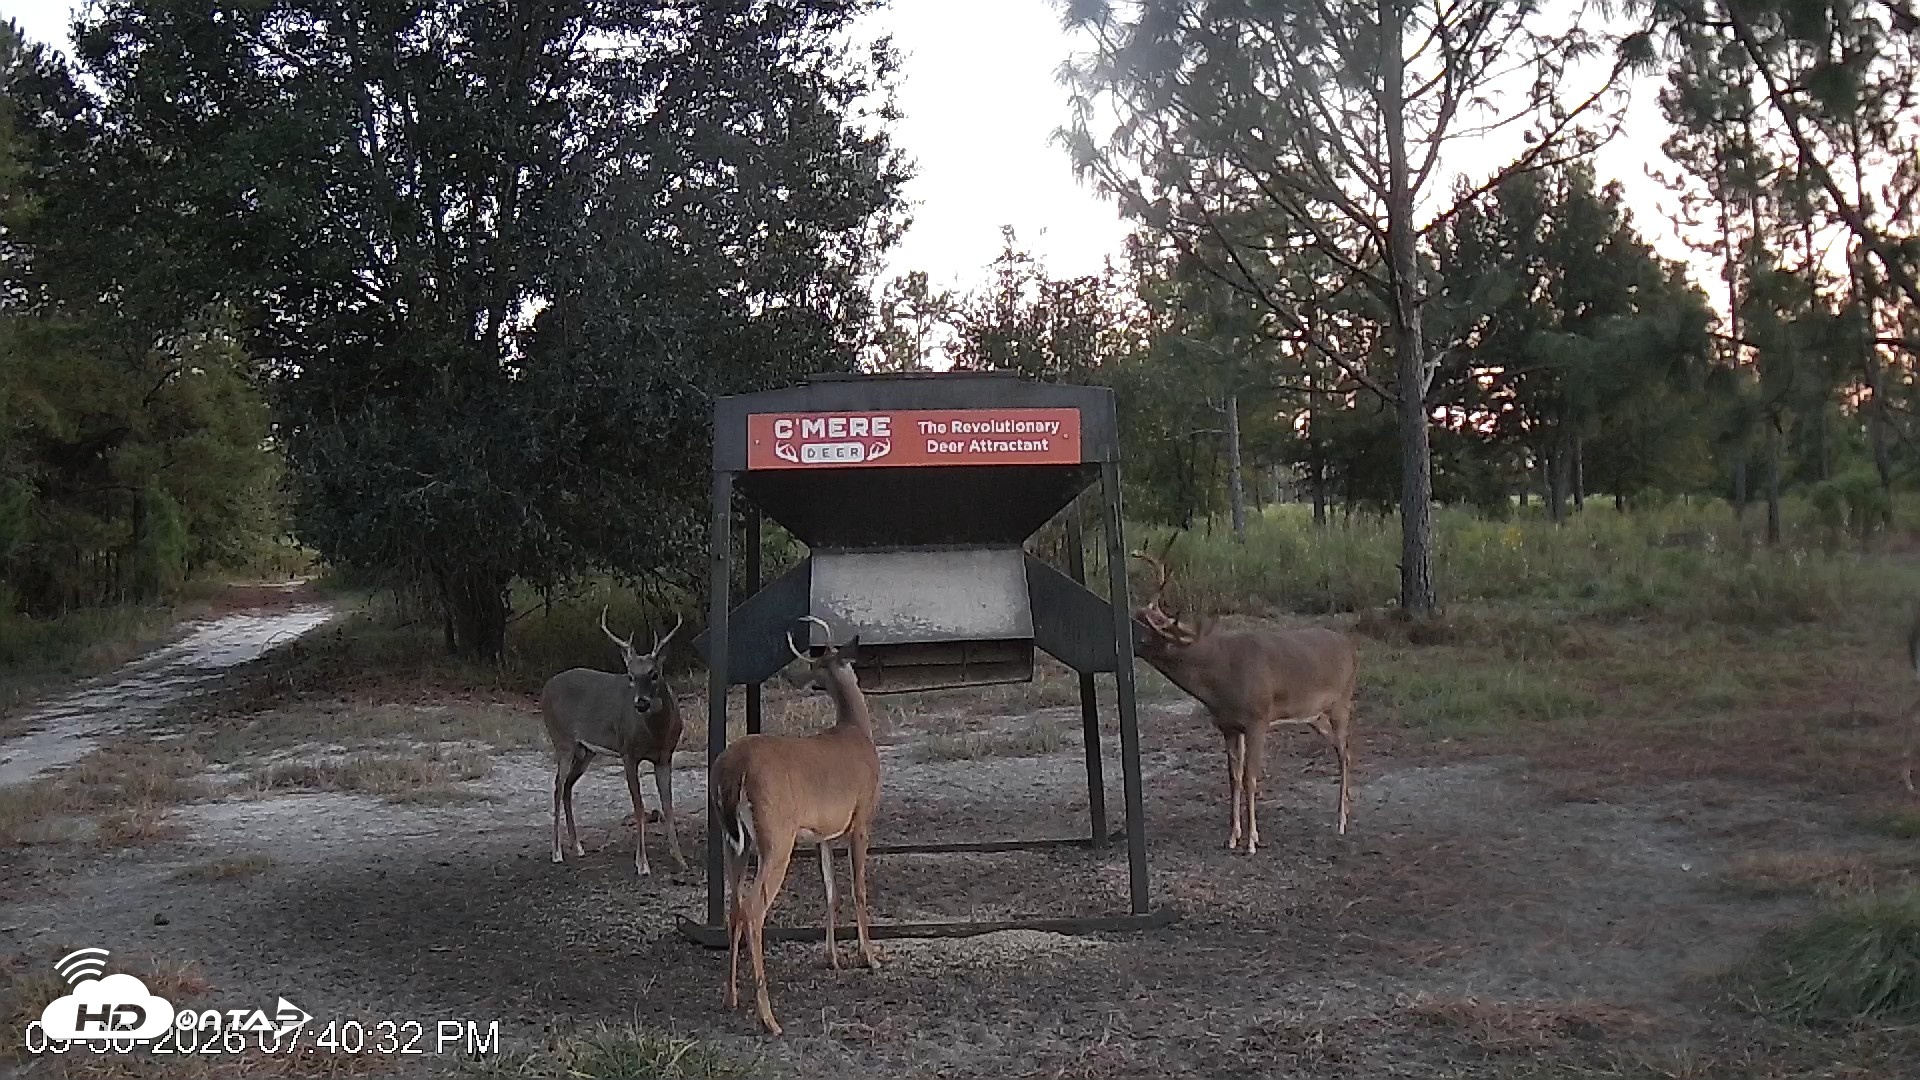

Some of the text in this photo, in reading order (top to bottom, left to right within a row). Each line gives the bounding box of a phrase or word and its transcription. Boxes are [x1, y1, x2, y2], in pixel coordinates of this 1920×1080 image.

[774, 416, 892, 439] C'MERE
[917, 419, 1060, 435] The Revolutionary
[807, 447, 859, 459] DEER
[926, 438, 1049, 453] Deer Attractant
